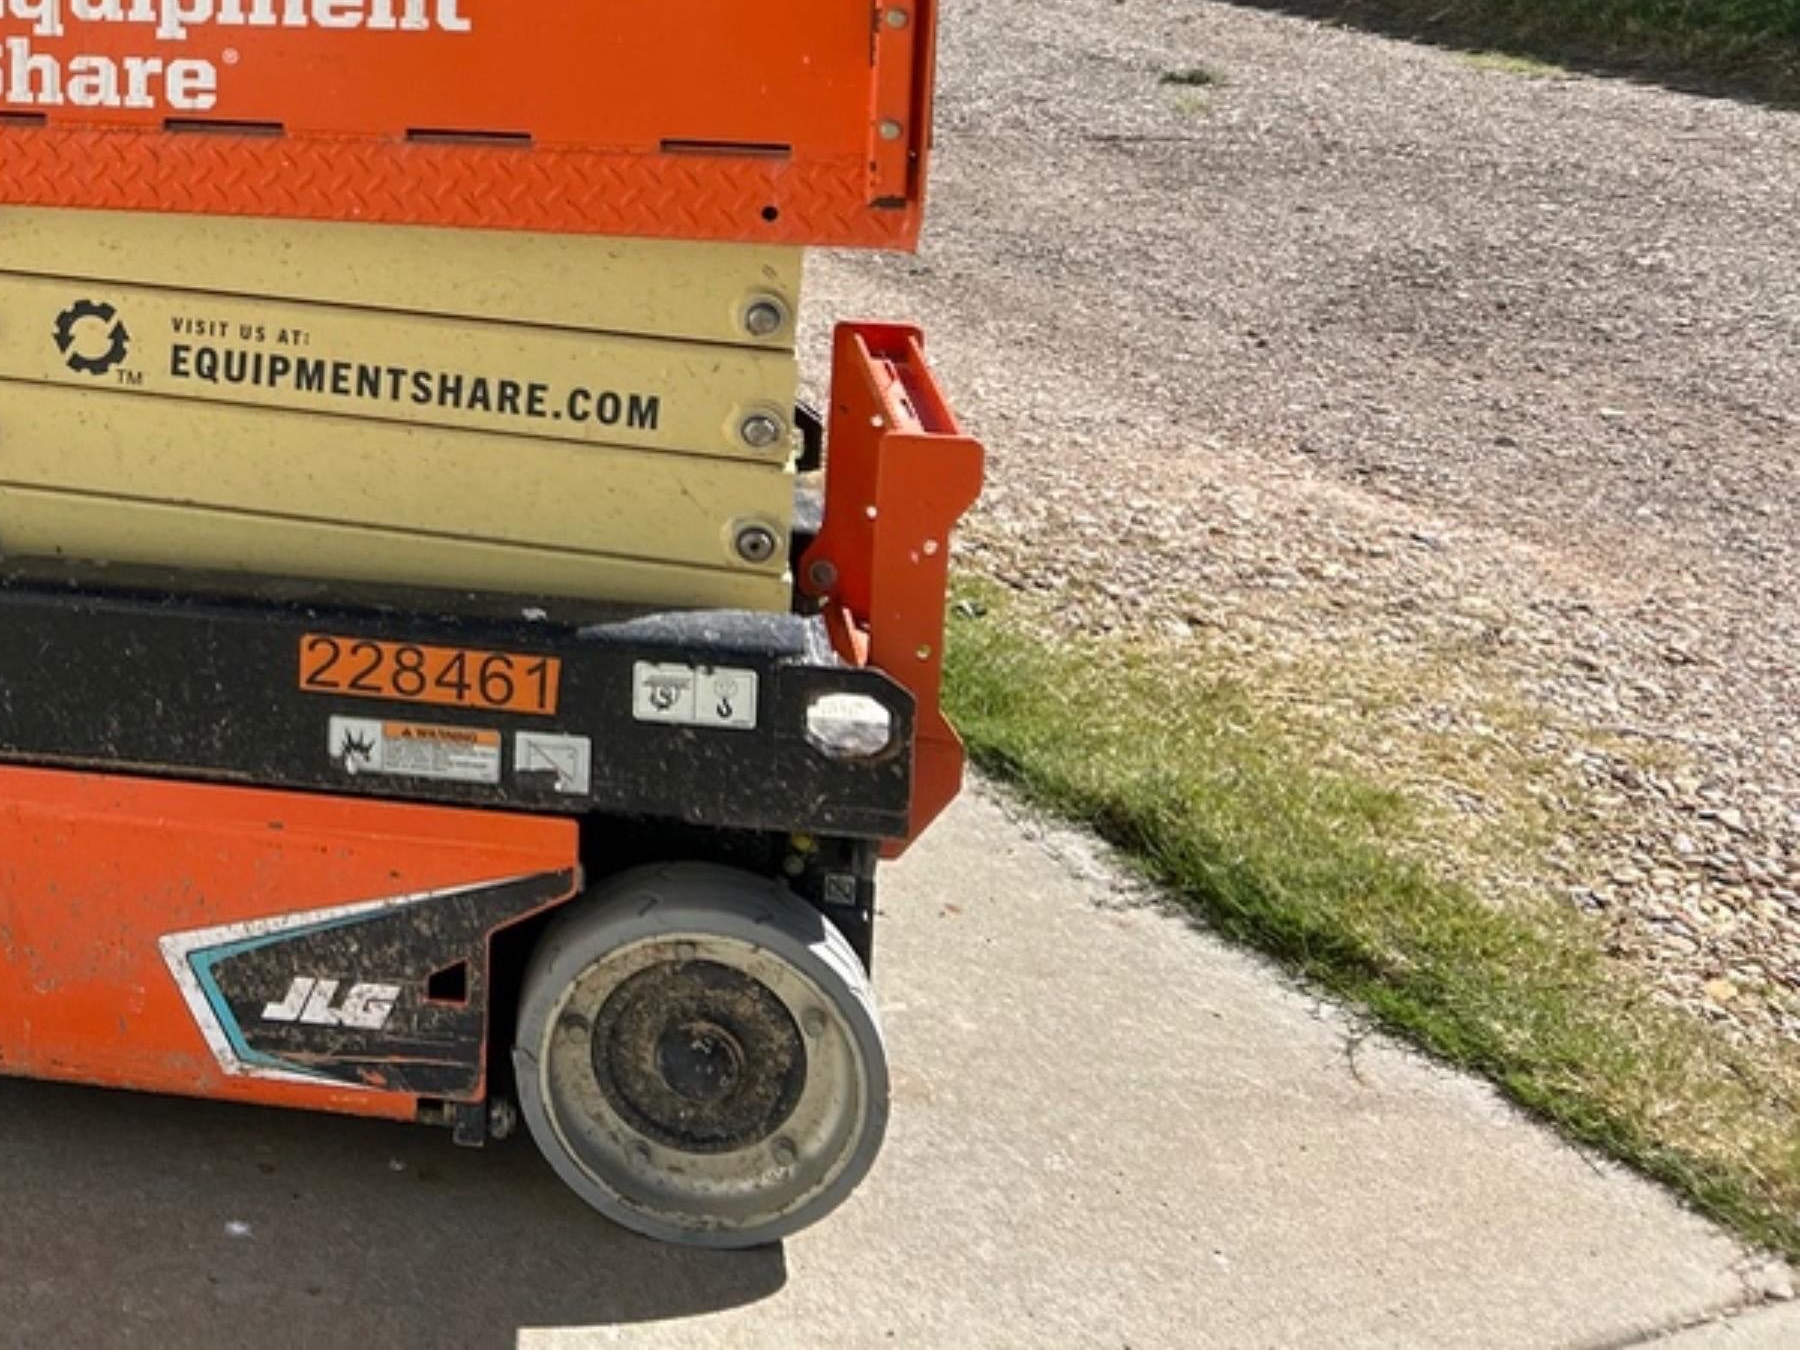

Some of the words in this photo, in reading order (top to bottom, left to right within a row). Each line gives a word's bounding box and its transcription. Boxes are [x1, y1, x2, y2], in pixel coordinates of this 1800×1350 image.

[171, 317, 229, 338] VISIT
[239, 323, 266, 341] US
[277, 328, 311, 346] AT:
[117, 369, 143, 385] TM
[169, 344, 661, 430] EQUIPMENTSHARE.COM
[304, 637, 548, 709] 228461
[261, 977, 400, 1029] JLG
